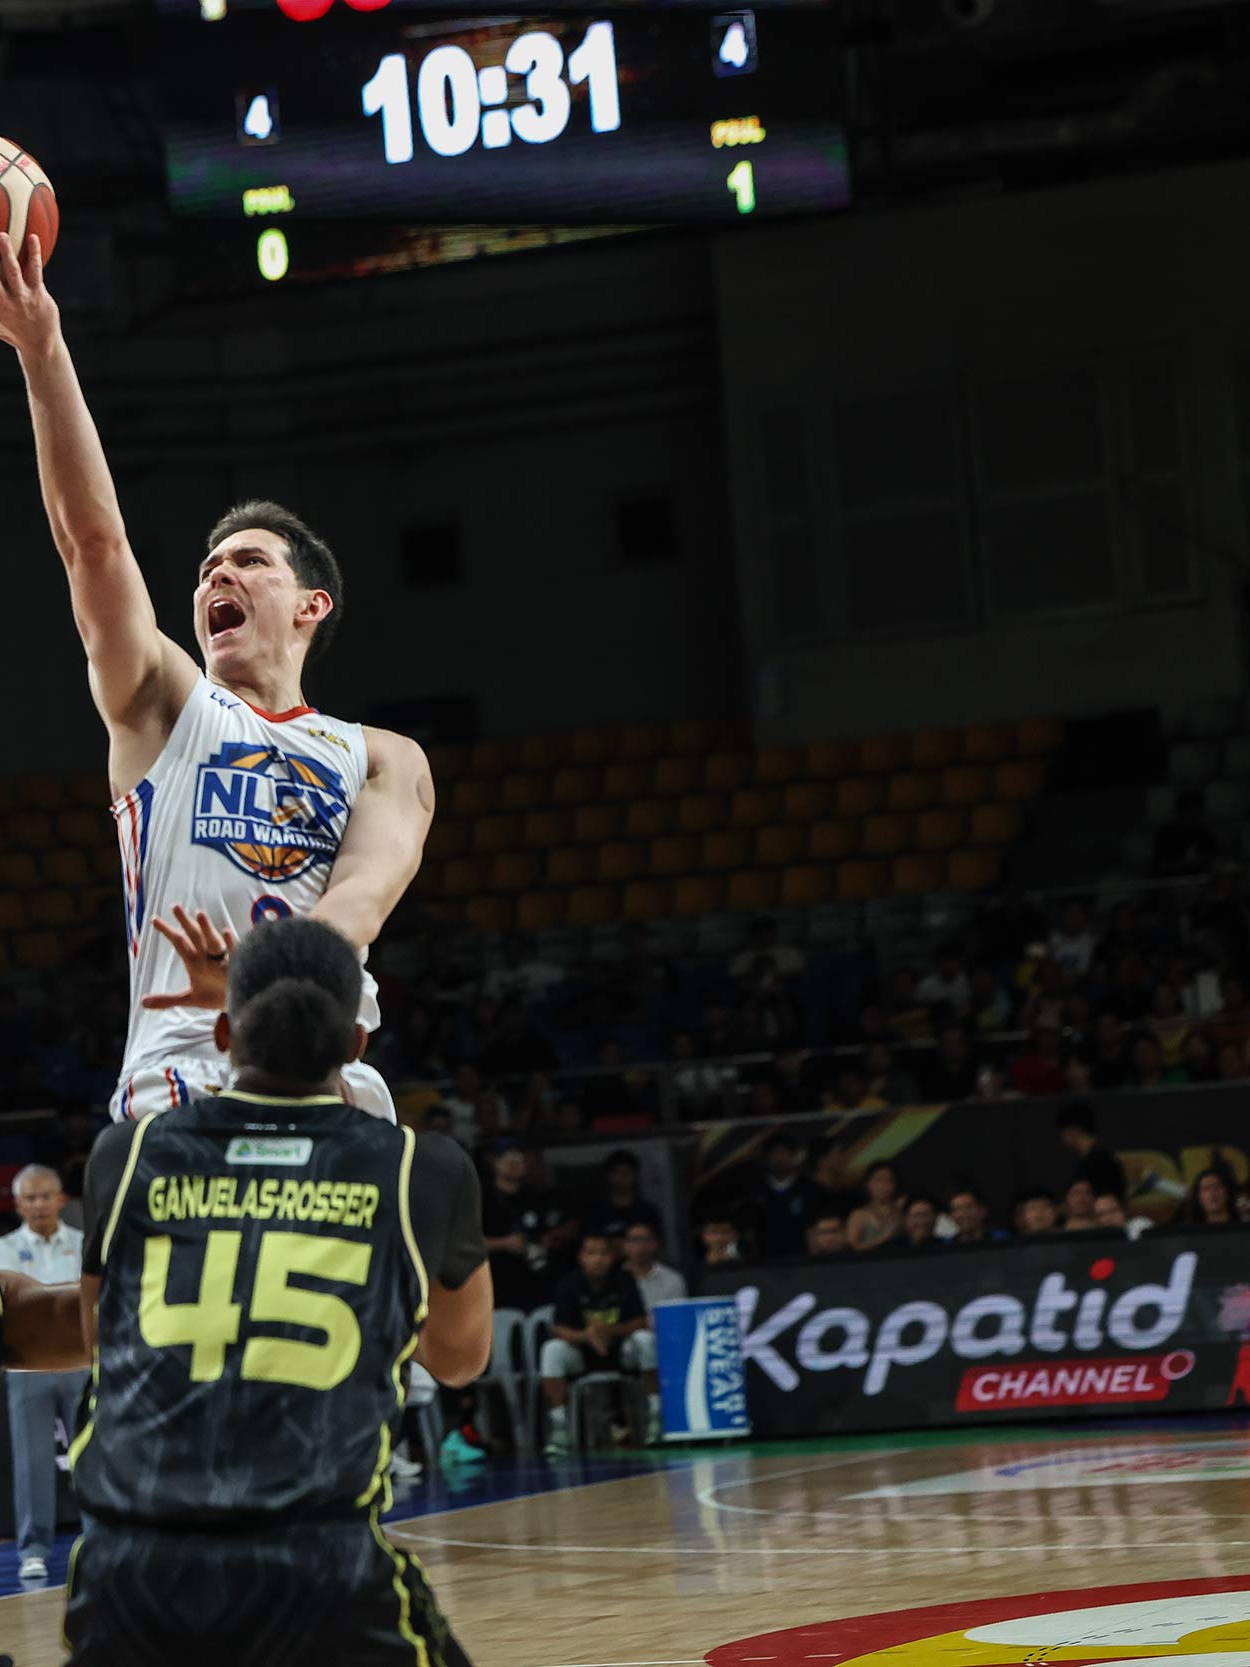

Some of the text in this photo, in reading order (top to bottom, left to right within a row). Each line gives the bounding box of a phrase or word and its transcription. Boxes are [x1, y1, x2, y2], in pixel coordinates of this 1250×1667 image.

[720, 22, 748, 67] 4
[244, 94, 273, 139] 4
[361, 20, 622, 164] 10:31
[727, 160, 756, 214] 1
[257, 228, 289, 281] 0
[194, 818, 247, 840] ROAD
[148, 1175, 381, 1230] GANUELAS-ROSSER
[138, 1229, 374, 1391] 45
[734, 1251, 1198, 1396] Kapatid
[971, 1364, 1155, 1402] CHANNEL
